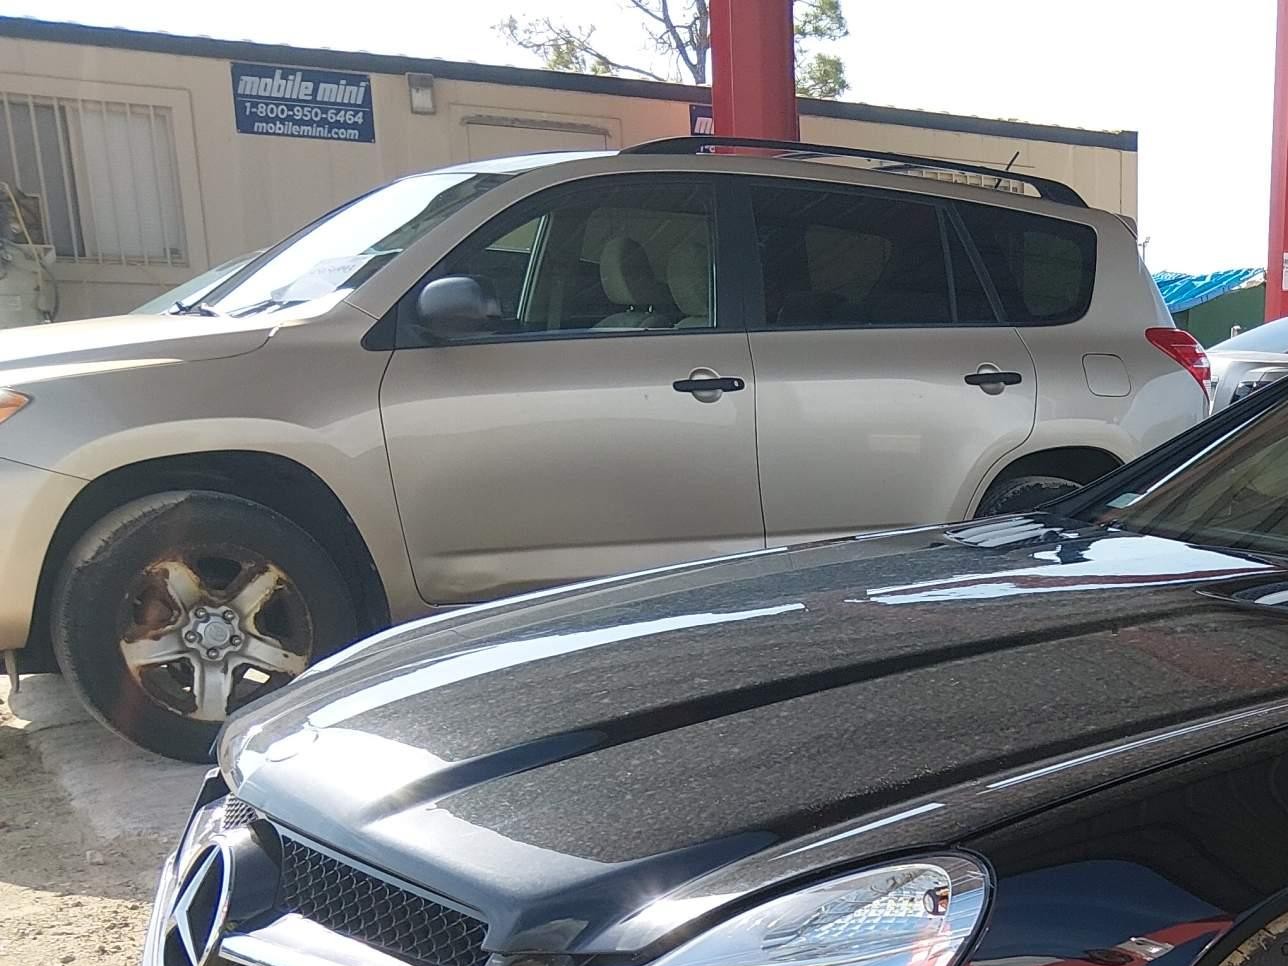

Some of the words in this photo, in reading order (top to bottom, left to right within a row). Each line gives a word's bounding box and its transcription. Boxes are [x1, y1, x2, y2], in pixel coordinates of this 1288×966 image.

[238, 69, 314, 100] mobile
[317, 79, 368, 104] mini
[244, 102, 364, 125] 1-800-950-6464
[254, 121, 359, 140] mobilemini.com
